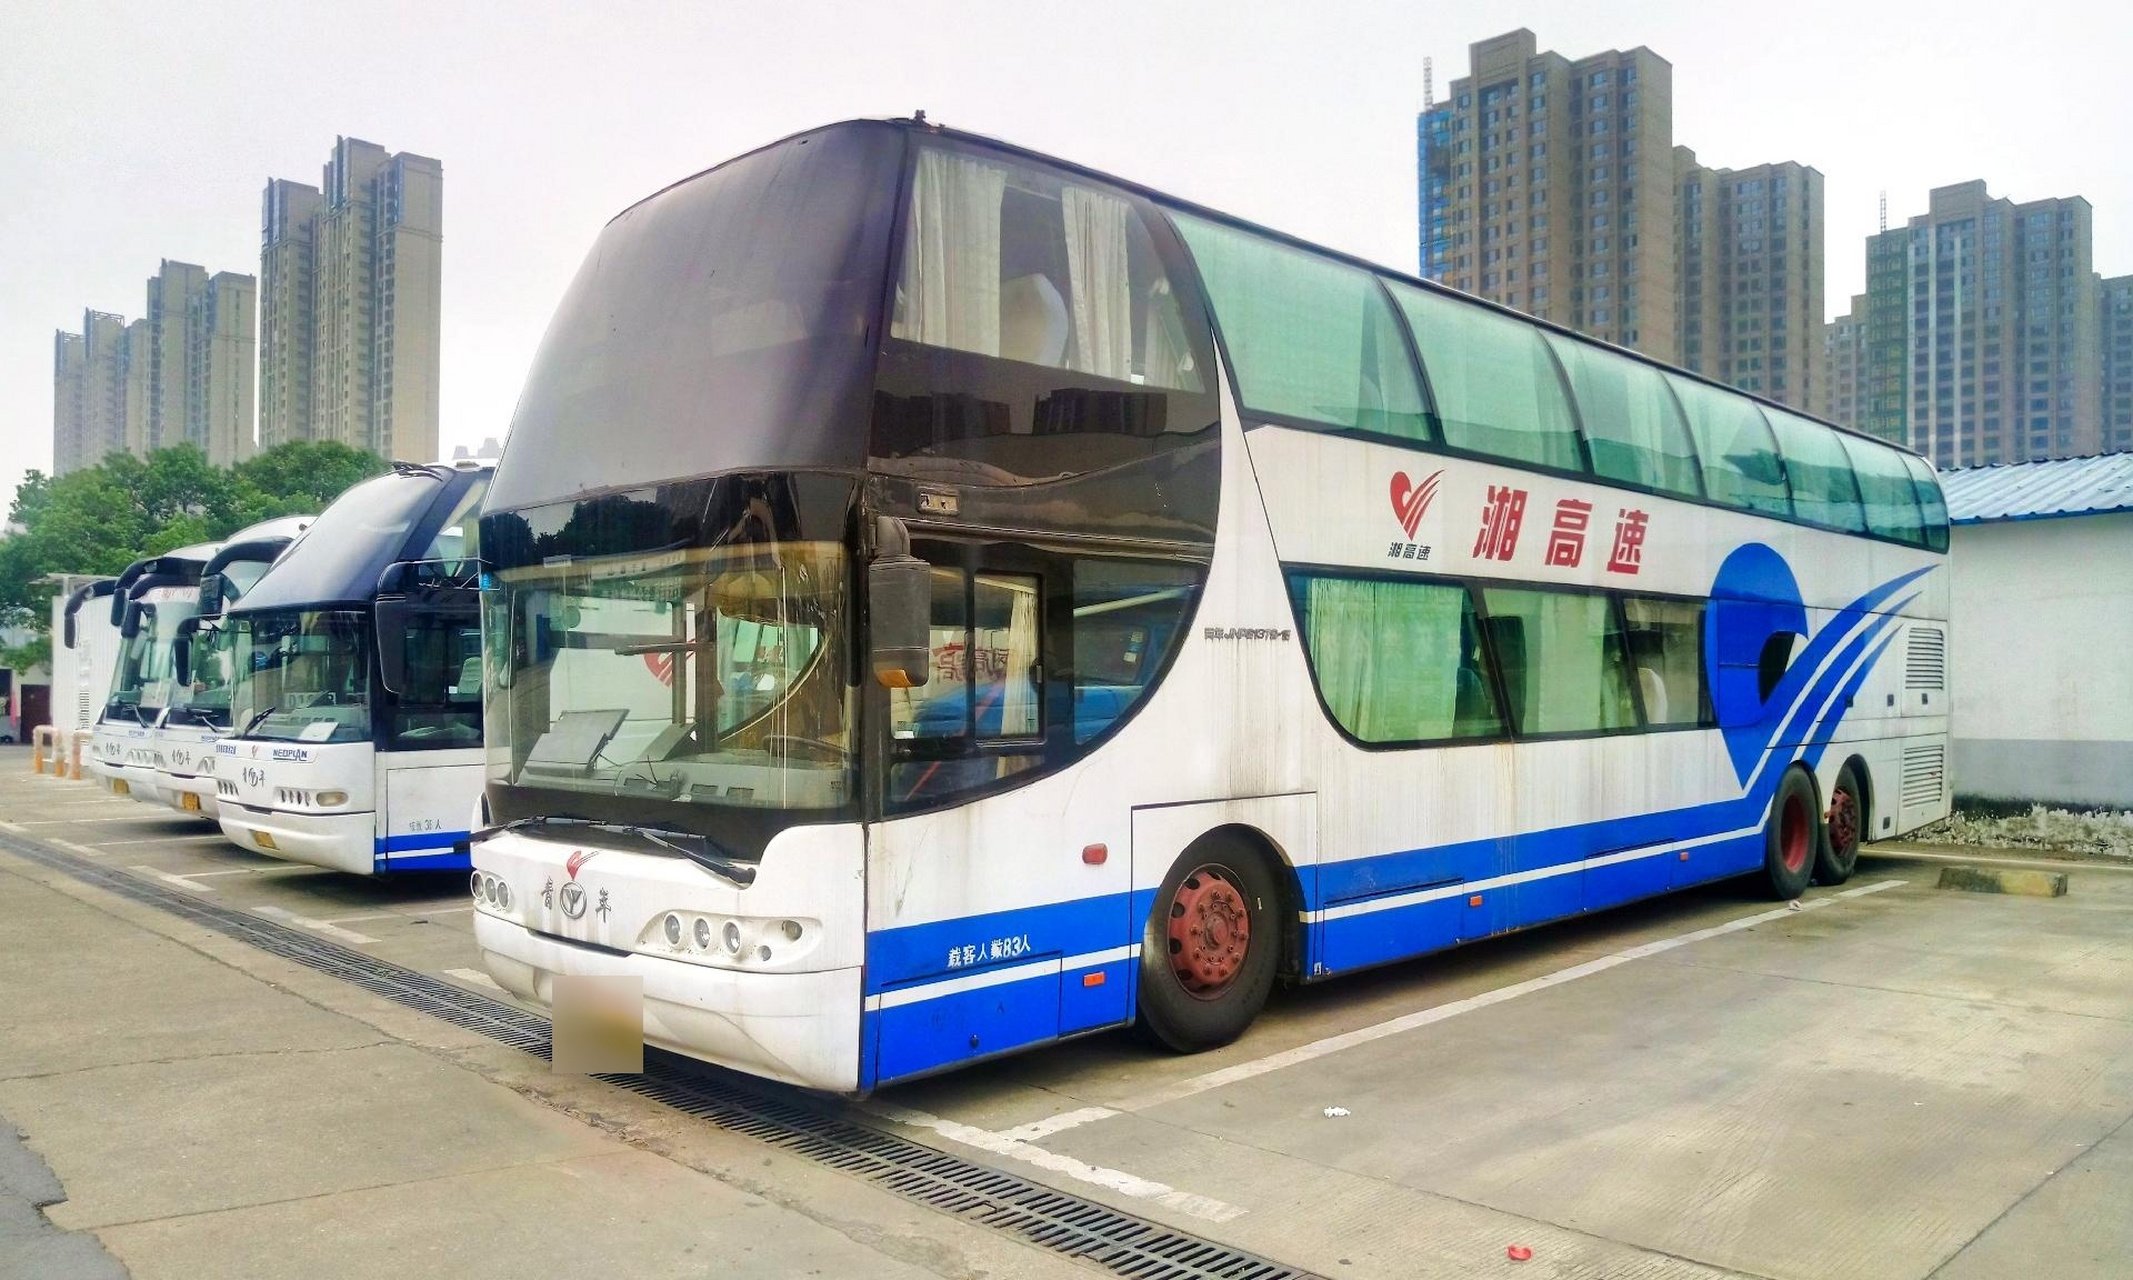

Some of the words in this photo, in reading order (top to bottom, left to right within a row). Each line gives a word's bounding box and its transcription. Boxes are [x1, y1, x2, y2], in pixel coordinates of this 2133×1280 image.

[1472, 485, 1650, 575] 湘高速
[1387, 541, 1431, 561] 湘高速
[273, 749, 308, 761] NEOPLAN
